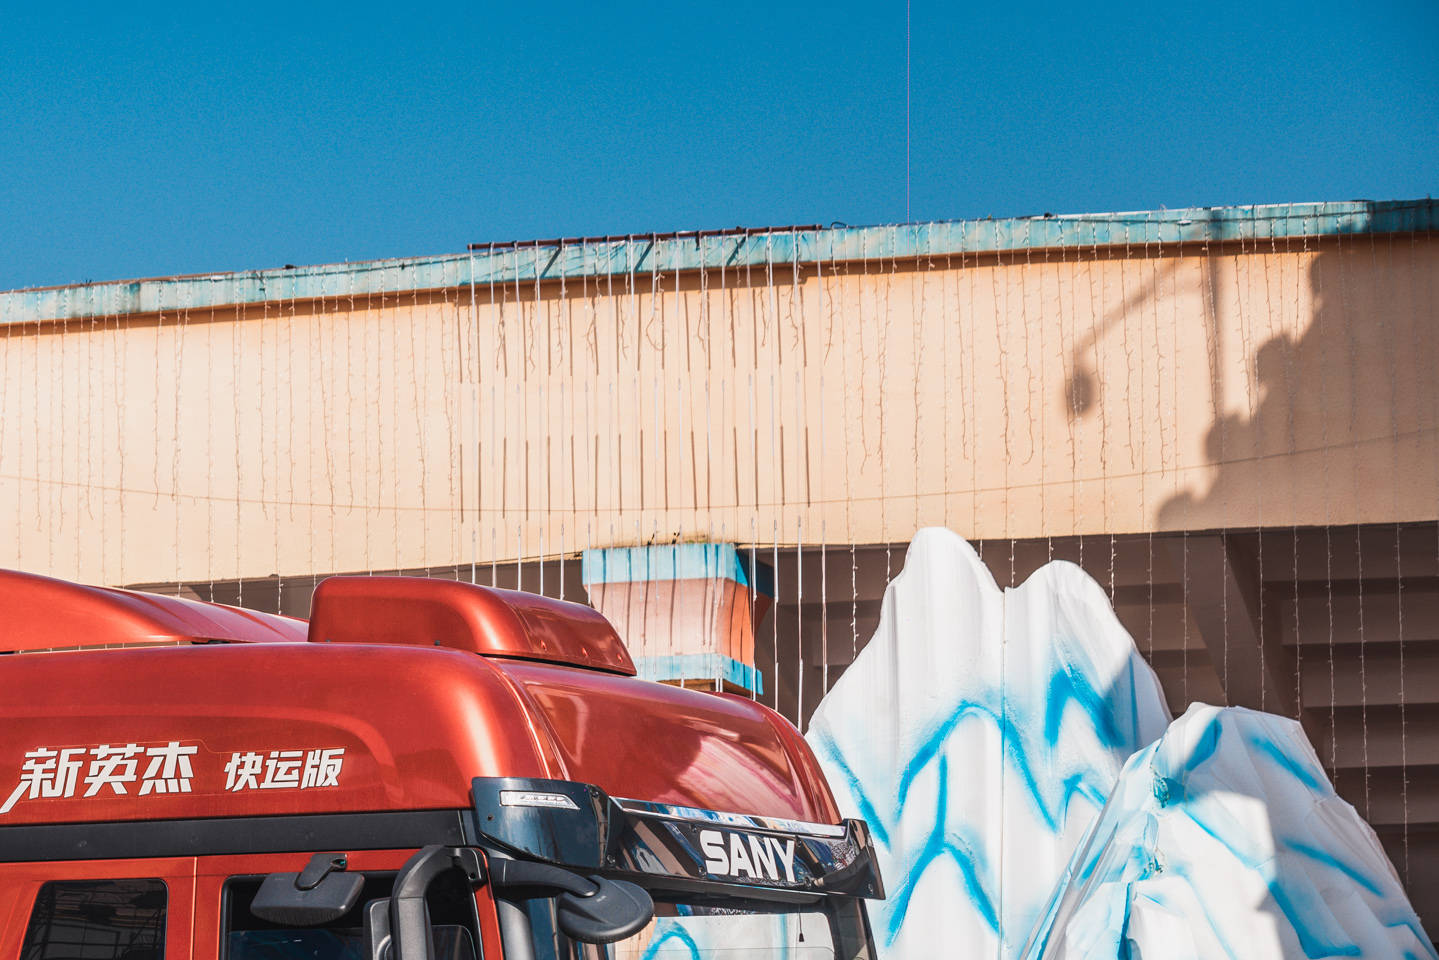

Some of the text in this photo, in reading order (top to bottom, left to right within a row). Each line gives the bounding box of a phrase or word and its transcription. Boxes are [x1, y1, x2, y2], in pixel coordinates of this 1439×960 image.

[224, 748, 345, 792] 快运版
[700, 829, 796, 883] SANY
